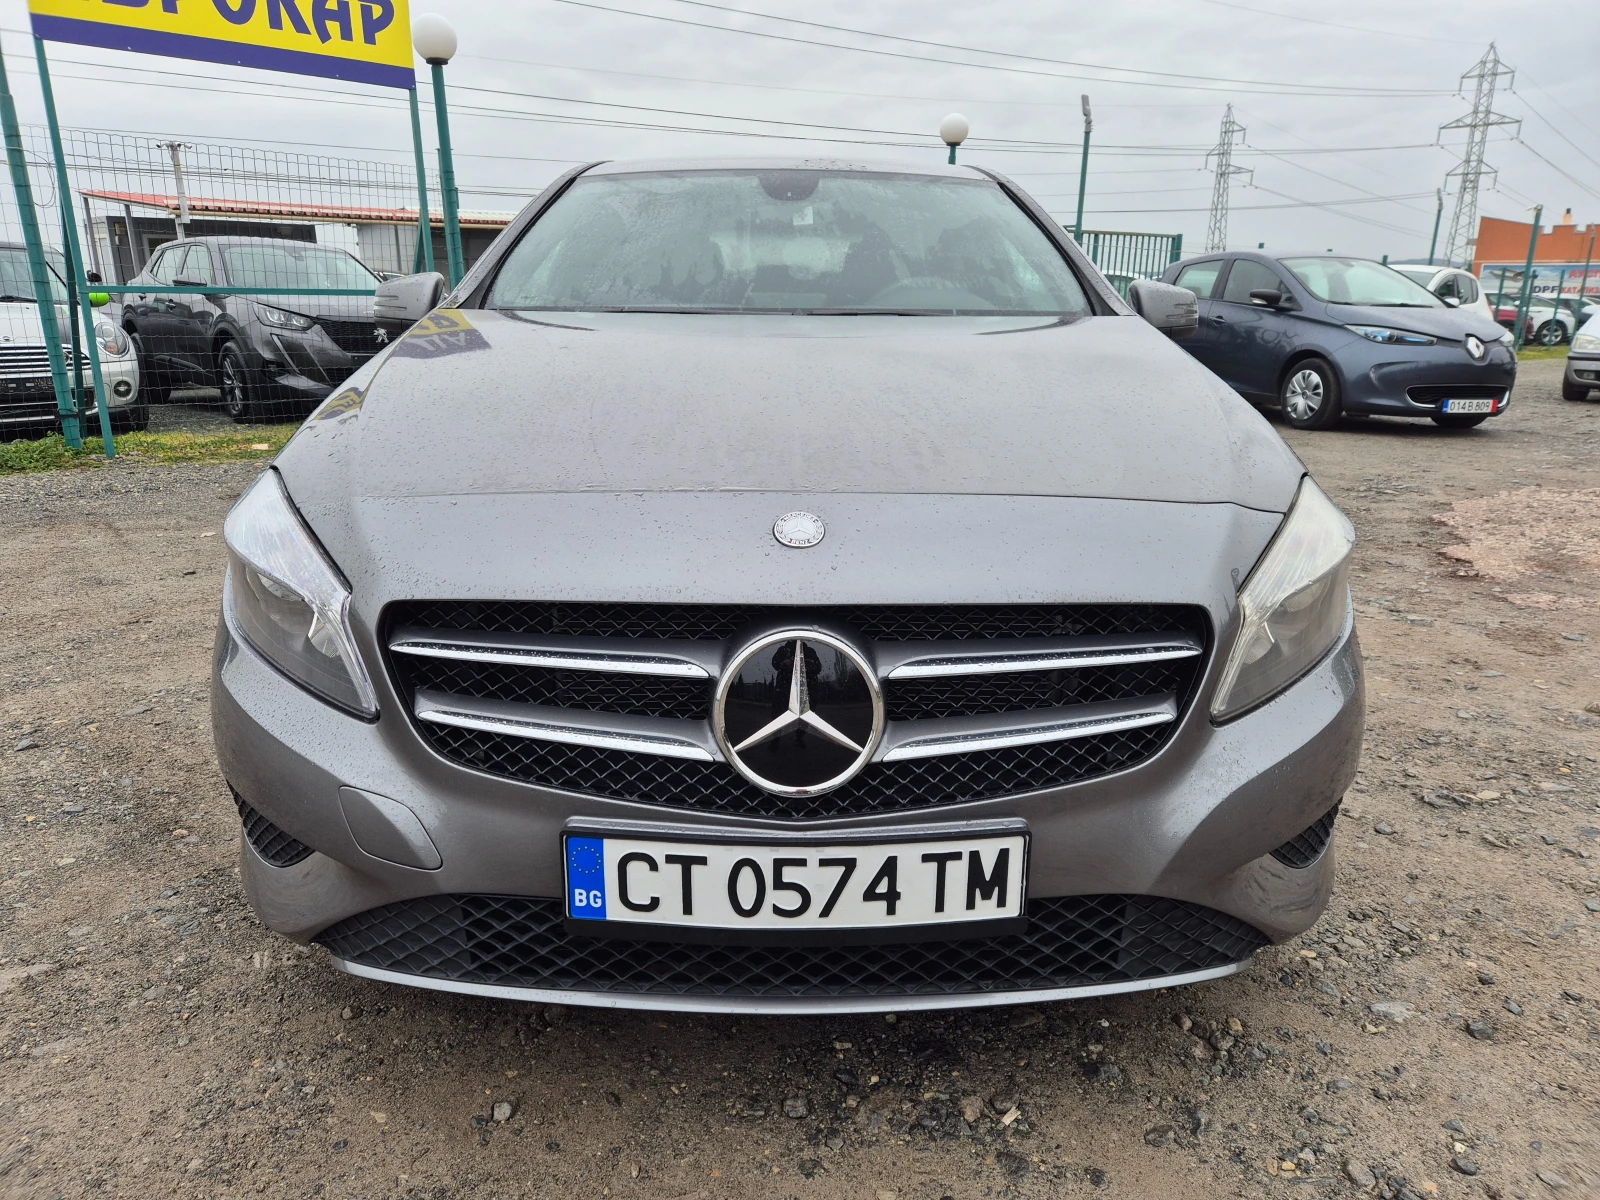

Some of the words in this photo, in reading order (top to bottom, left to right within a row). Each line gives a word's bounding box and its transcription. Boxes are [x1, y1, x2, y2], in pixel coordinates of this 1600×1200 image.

[1533, 285, 1559, 294] DPF
[618, 851, 708, 916] CT
[728, 856, 902, 918] 0574
[921, 848, 1011, 913] TM
[574, 888, 603, 908] BG
